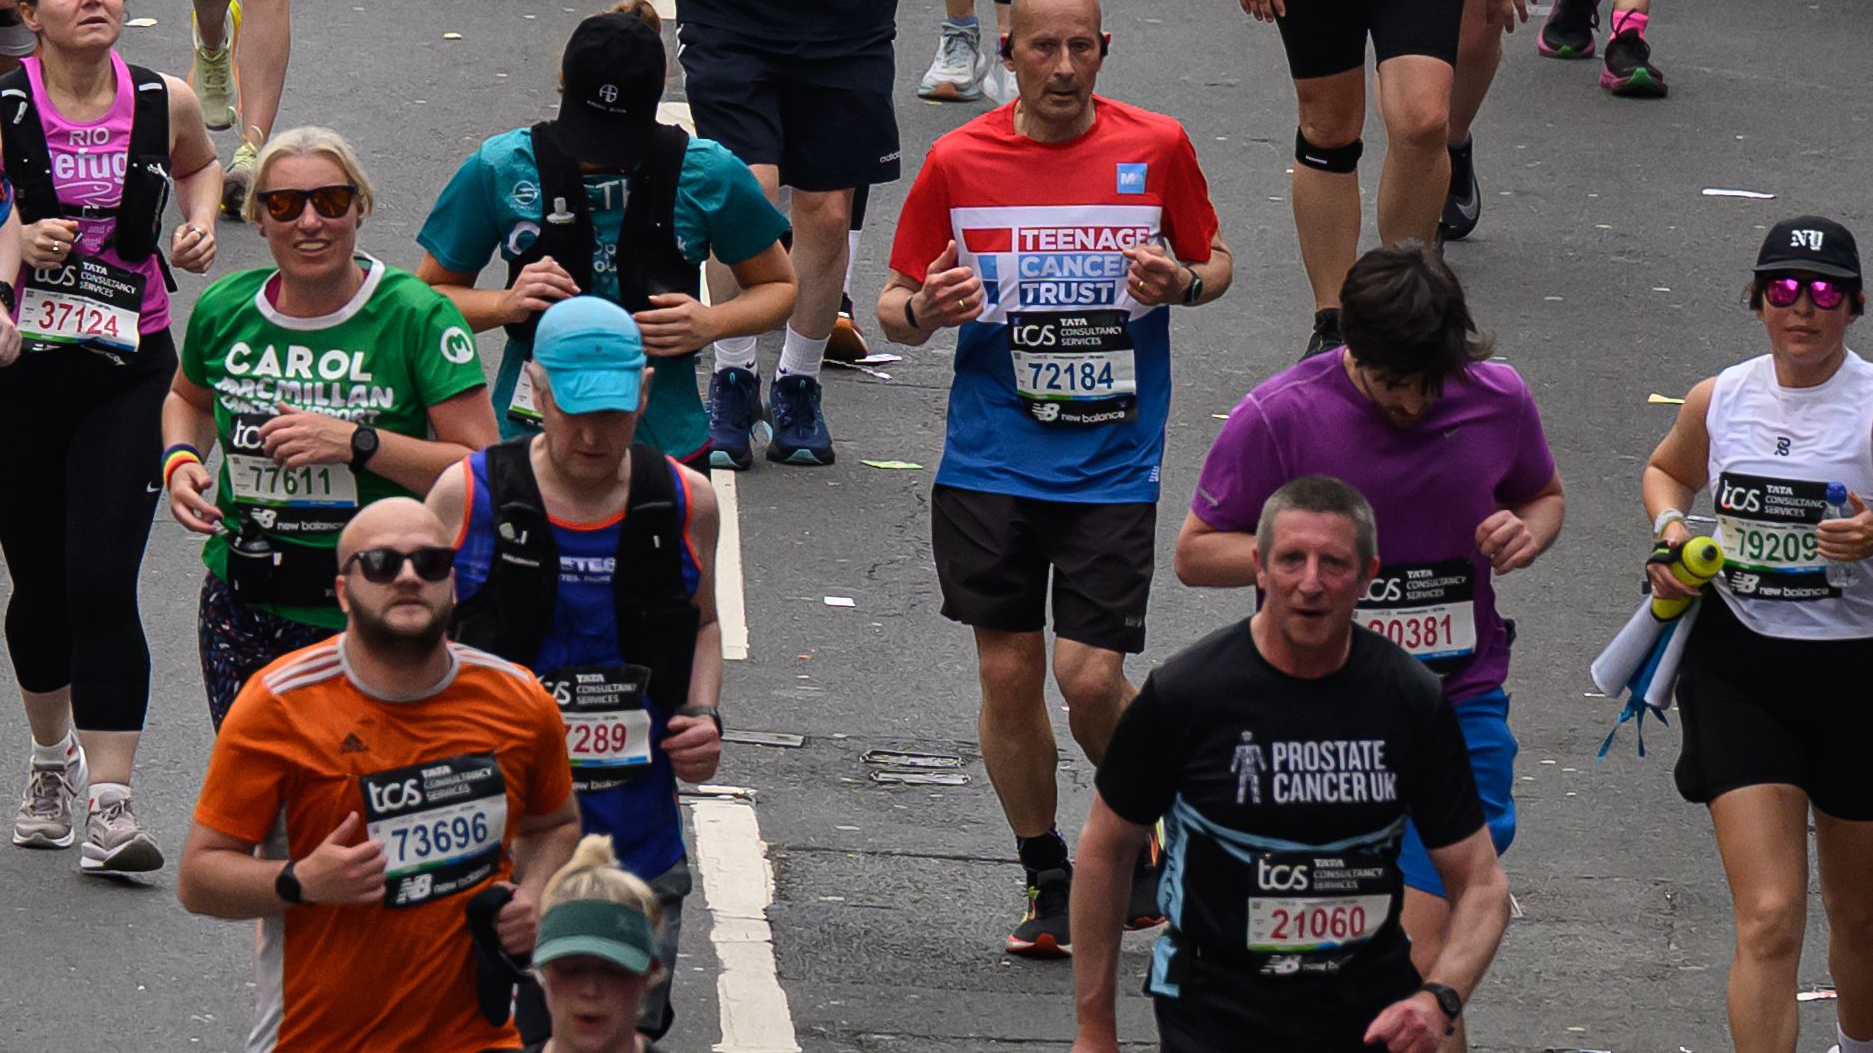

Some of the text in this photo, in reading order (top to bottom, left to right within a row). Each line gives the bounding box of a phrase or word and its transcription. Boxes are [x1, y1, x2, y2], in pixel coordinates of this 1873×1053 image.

[69, 127, 110, 145] RIO
[1020, 228, 1150, 251] TEENAGE
[81, 261, 108, 276] TATA
[78, 280, 114, 298] SERVICES
[80, 271, 136, 296] CONSULTANCY
[1020, 279, 1114, 305] TRUST
[38, 299, 119, 338] 37124
[1060, 318, 1088, 327] TATA
[1060, 326, 1122, 338] CONSULTANCY
[1061, 336, 1102, 346] SERVICES
[224, 341, 373, 383] CAROL
[1028, 360, 1115, 392] 72184
[1081, 410, 1126, 423] balance
[249, 465, 332, 495] 77611
[1720, 479, 1793, 513] tcs TATA
[1764, 505, 1805, 518] SERVICES
[298, 519, 346, 532] balance
[1734, 527, 1818, 562] 79209
[1759, 586, 1782, 597] new
[1272, 740, 1386, 773] PROSTATE
[368, 765, 451, 814] tcs TATA
[1272, 772, 1398, 804] CANCER UK
[391, 811, 489, 863] 73696
[1257, 858, 1345, 891] tcs TATA
[1270, 906, 1366, 941] 21060
